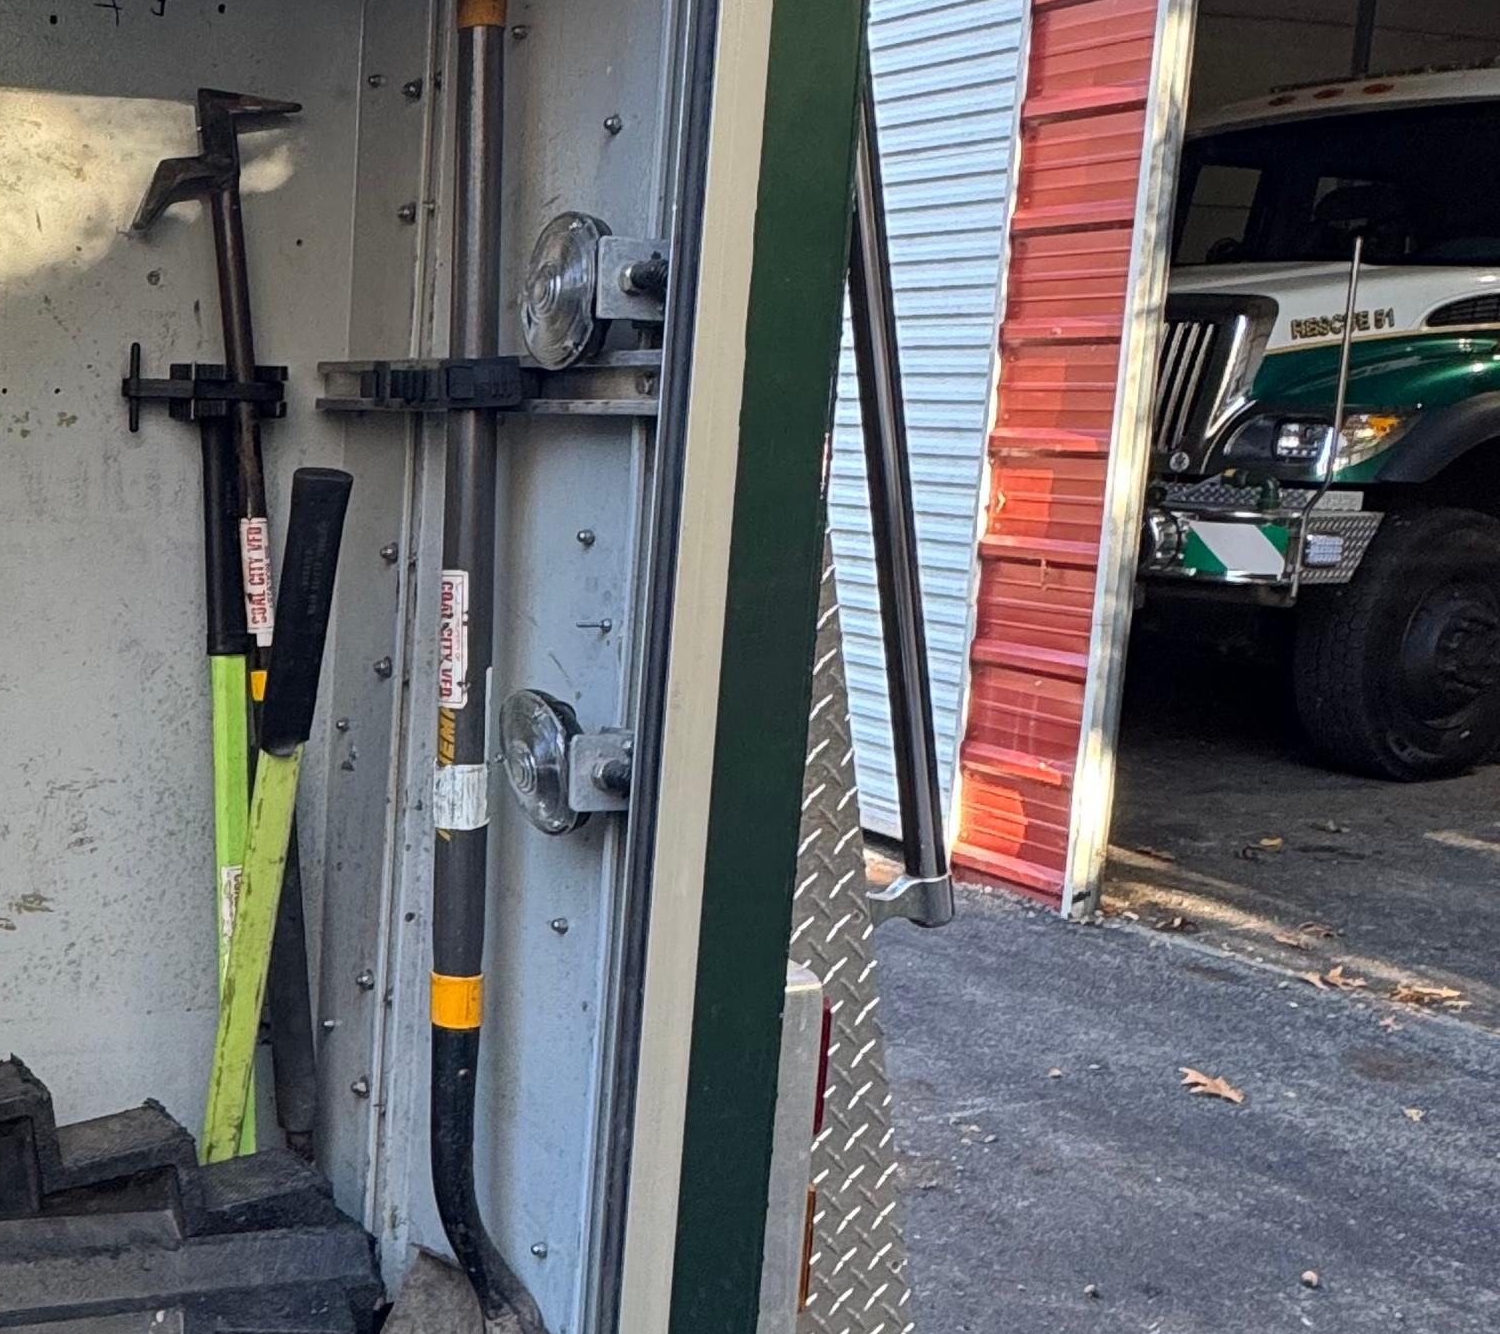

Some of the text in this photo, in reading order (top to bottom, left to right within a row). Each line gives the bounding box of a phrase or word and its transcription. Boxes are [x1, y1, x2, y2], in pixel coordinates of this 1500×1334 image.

[246, 526, 267, 624] COAL CITY VFD
